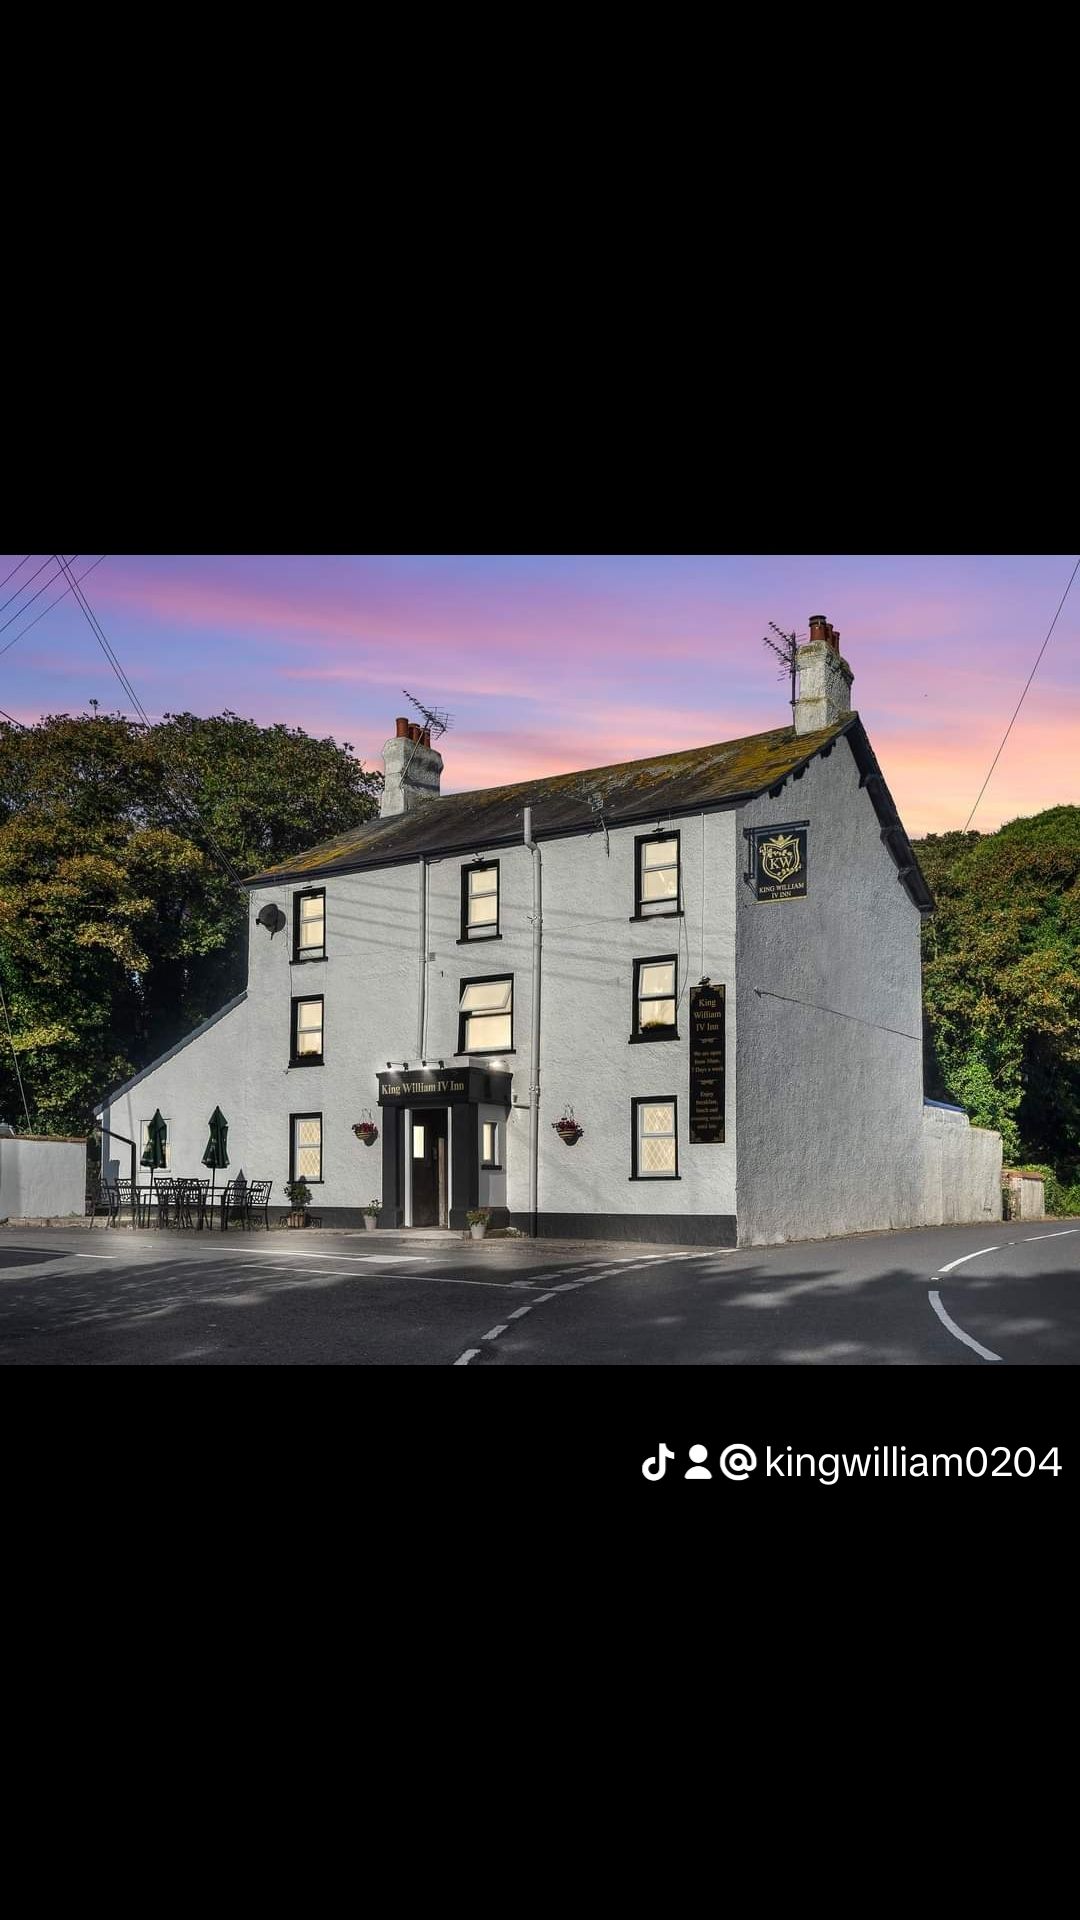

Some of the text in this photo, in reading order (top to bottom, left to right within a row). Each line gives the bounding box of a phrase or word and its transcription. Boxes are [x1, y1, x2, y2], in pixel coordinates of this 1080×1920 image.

[770, 855, 794, 870] KW
[760, 882, 805, 893] KING WILLIAM
[780, 890, 792, 898] INN
[698, 999, 717, 1008] King
[694, 1010, 722, 1019] William
[696, 1022, 719, 1031] IV Inn
[381, 1081, 465, 1096] King William IV Inn
